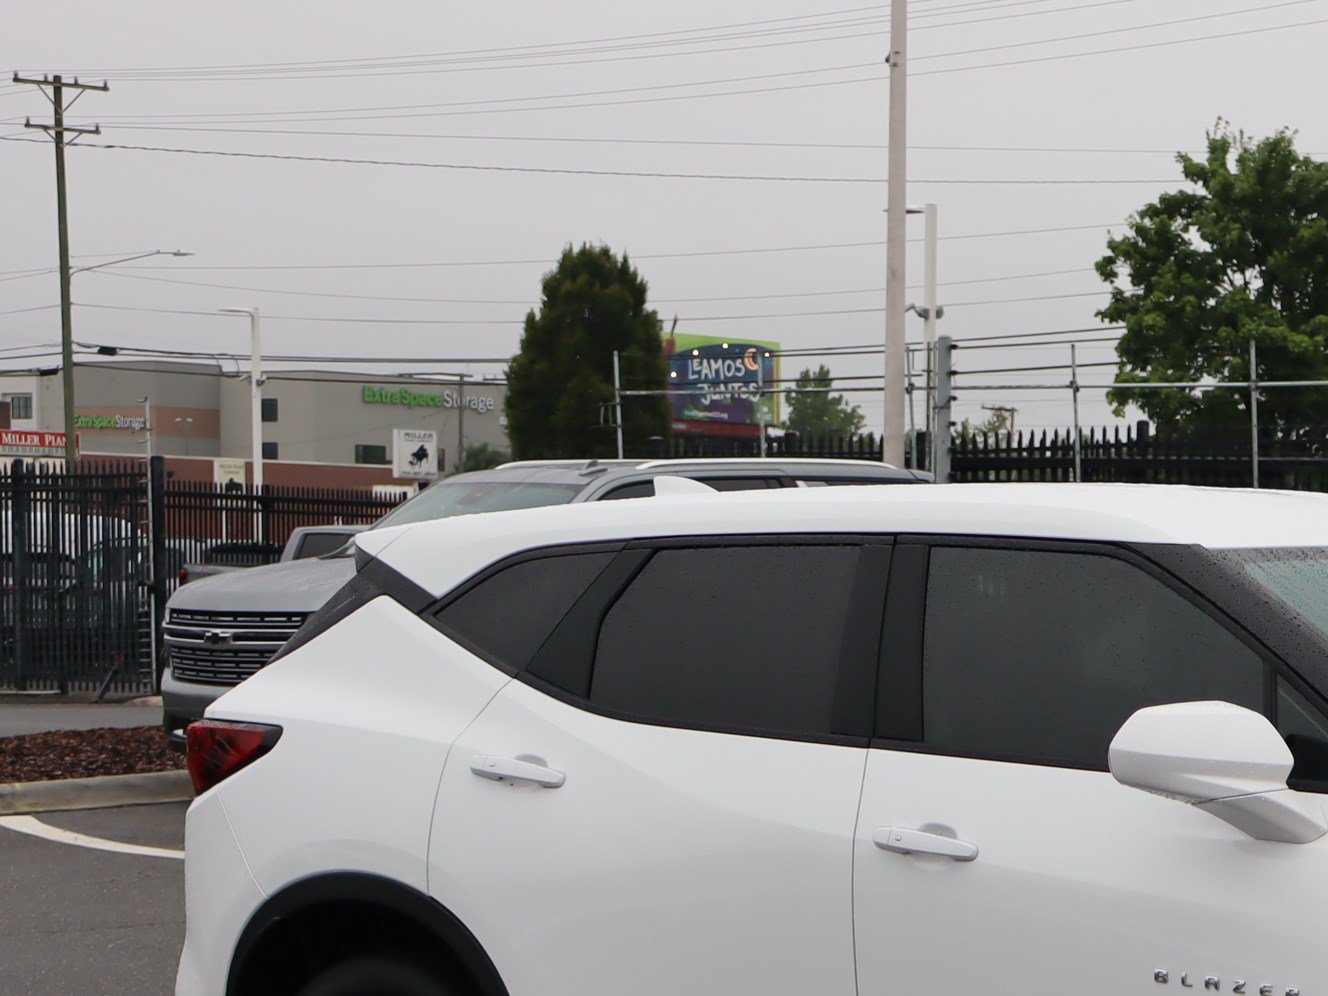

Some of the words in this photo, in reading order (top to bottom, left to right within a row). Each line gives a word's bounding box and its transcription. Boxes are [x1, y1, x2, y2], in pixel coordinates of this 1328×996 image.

[688, 359, 745, 379] LEAMOS
[698, 382, 760, 405] JUNTOS
[2, 433, 40, 445] MILLER
